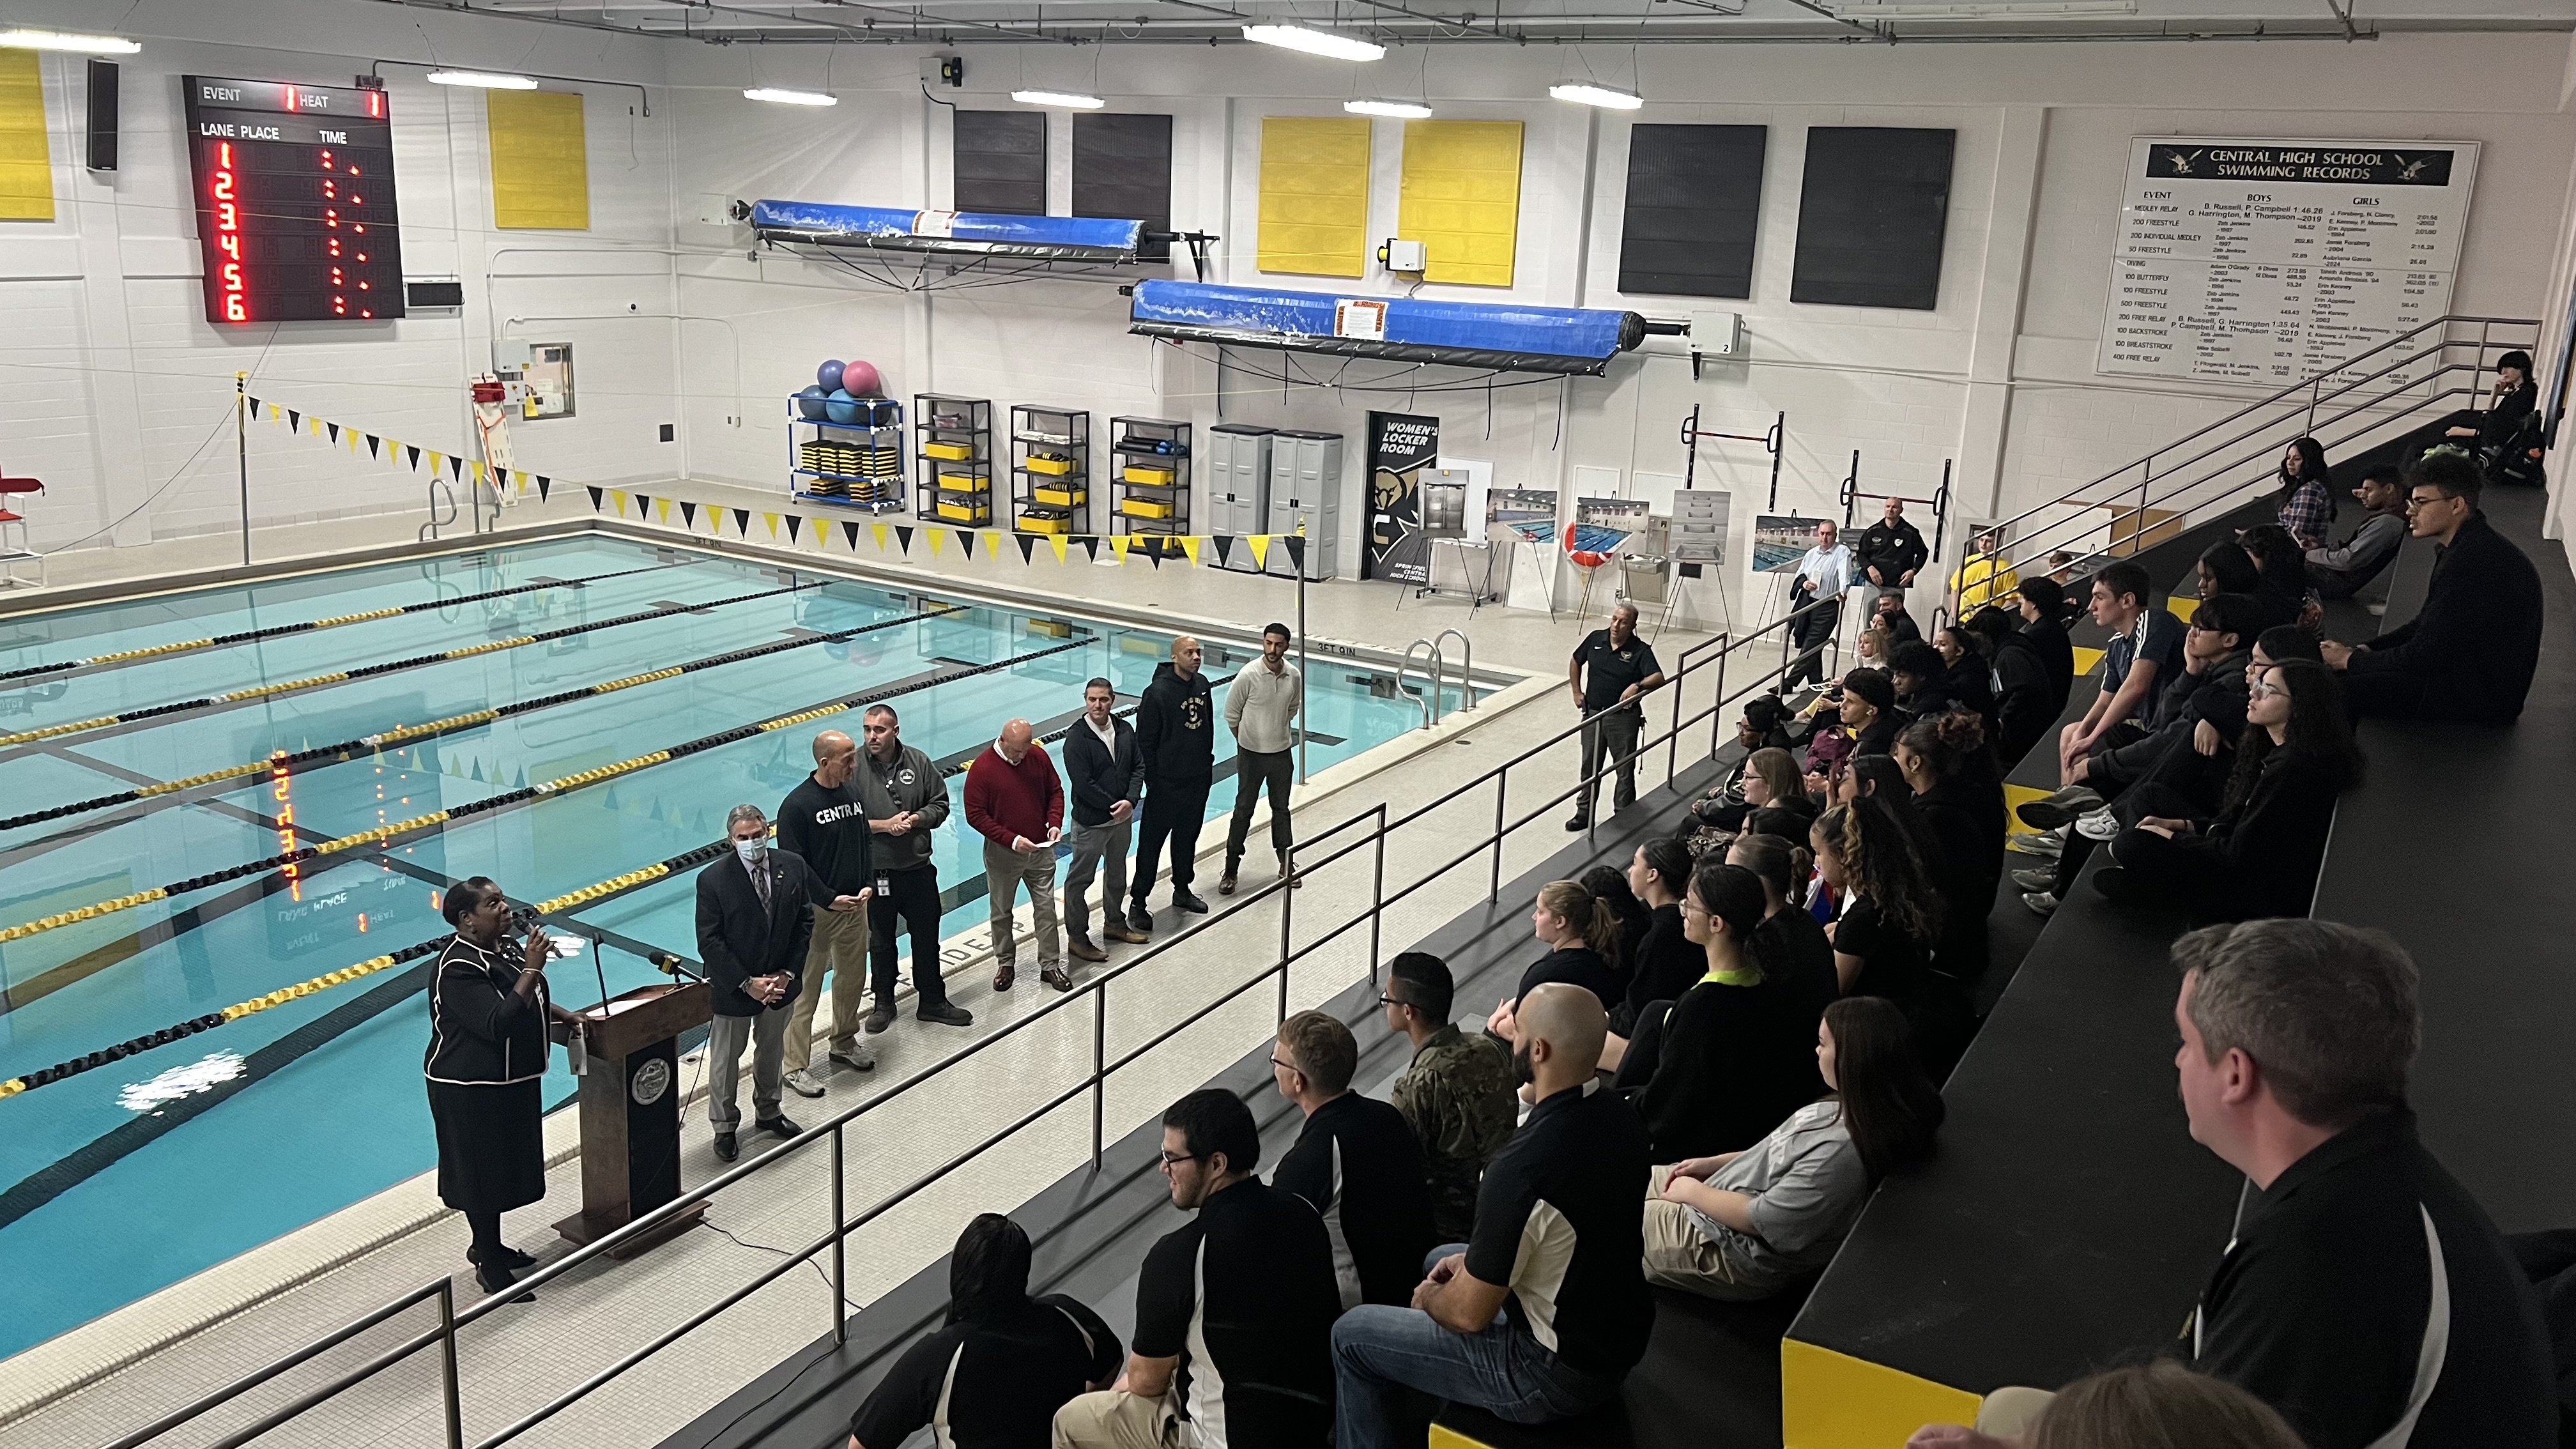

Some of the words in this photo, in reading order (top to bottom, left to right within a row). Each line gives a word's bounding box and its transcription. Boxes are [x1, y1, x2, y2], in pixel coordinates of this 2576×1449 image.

[203, 86, 241, 102] EVENT
[300, 94, 328, 108] HEAT
[201, 123, 234, 137] LANE
[241, 125, 280, 140] PLACE
[319, 130, 347, 144] TIME
[220, 142, 231, 169] 1
[2210, 150, 2271, 163] CENTRAL
[2279, 152, 2315, 164] HIGH
[2323, 153, 2384, 165] SCHOOL
[2217, 165, 2296, 178] SWIMMING
[2303, 166, 2370, 180] RECORDS
[215, 172, 234, 199] 2
[2143, 191, 2172, 199] EVENT
[2247, 194, 2272, 202] BOYS
[2352, 197, 2380, 206] GIRLS
[2254, 205, 2291, 213] Campbell
[2255, 212, 2296, 220] Thompson
[218, 203, 237, 231] 3
[221, 234, 240, 261] 4
[224, 263, 243, 291] 5
[227, 294, 247, 321] 6
[2228, 319, 2270, 328] Harrington
[2229, 326, 2269, 335] Thompson
[2128, 328, 2168, 336] BACKSTROKE
[1723, 344, 1729, 353] 2
[2126, 341, 2173, 349] BREASTSTROKE
[1386, 422, 1438, 436] WOMEN'S
[1382, 432, 1429, 446] LOCKER
[1379, 443, 1416, 456] ROOM
[1318, 643, 1336, 654] 3FT
[1338, 647, 1356, 657] 9IN
